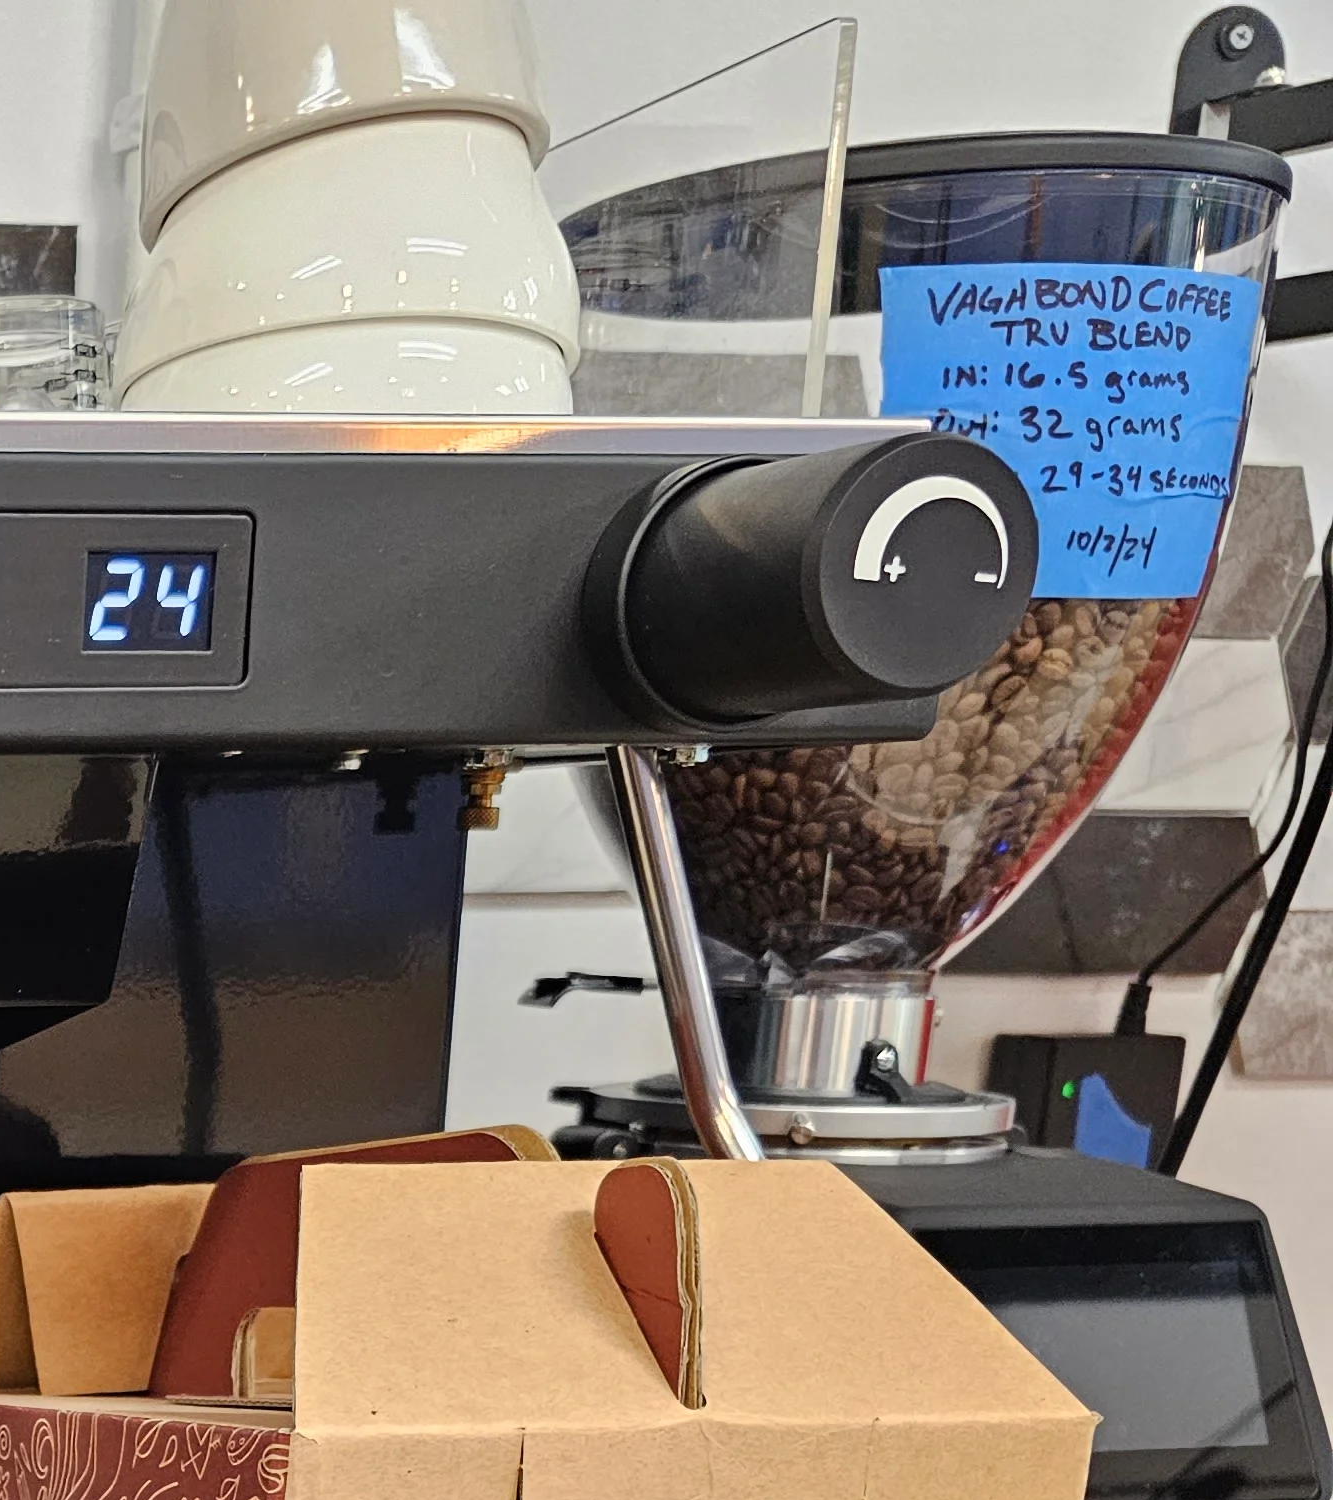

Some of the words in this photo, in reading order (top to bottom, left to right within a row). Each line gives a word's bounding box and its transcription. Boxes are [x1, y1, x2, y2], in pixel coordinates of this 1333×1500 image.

[1138, 278, 1231, 322] COFFEE
[1086, 317, 1192, 352] BLEND
[942, 363, 988, 390] IN:
[1004, 360, 1089, 389] 16.5
[1104, 367, 1191, 405] grams
[1019, 406, 1074, 443] 32
[1085, 413, 1182, 452] grams
[1039, 460, 1142, 497] 29-34
[1149, 466, 1231, 497] SECONDS
[88, 557, 206, 641] 24
